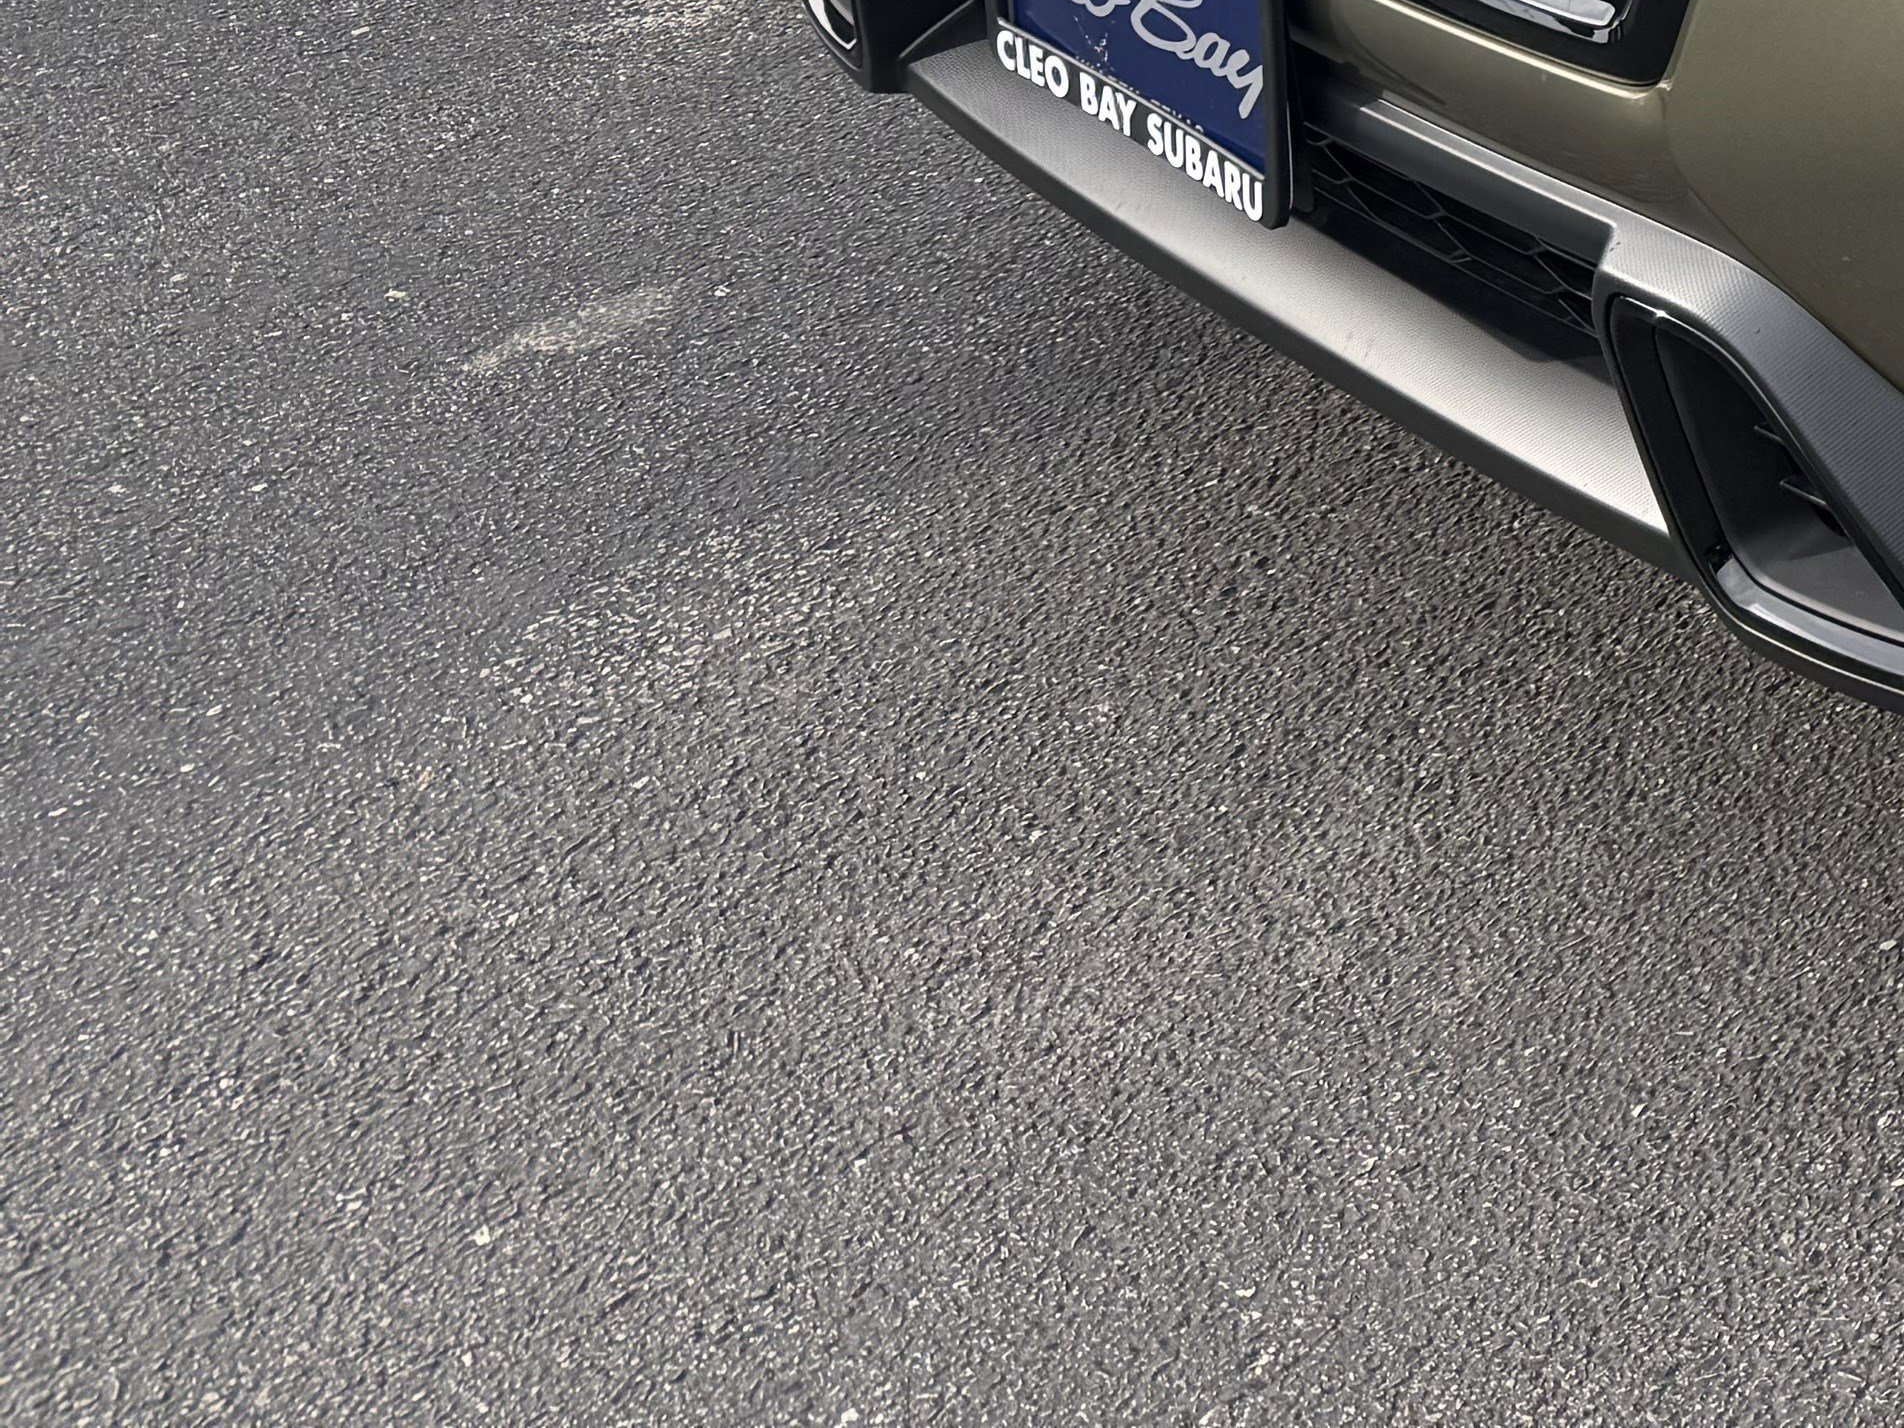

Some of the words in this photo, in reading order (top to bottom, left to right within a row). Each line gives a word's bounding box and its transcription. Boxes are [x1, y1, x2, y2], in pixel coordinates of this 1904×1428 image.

[997, 30, 1070, 99] CLEO
[1079, 69, 1138, 138] BAY
[1147, 112, 1263, 222] SUBARU
